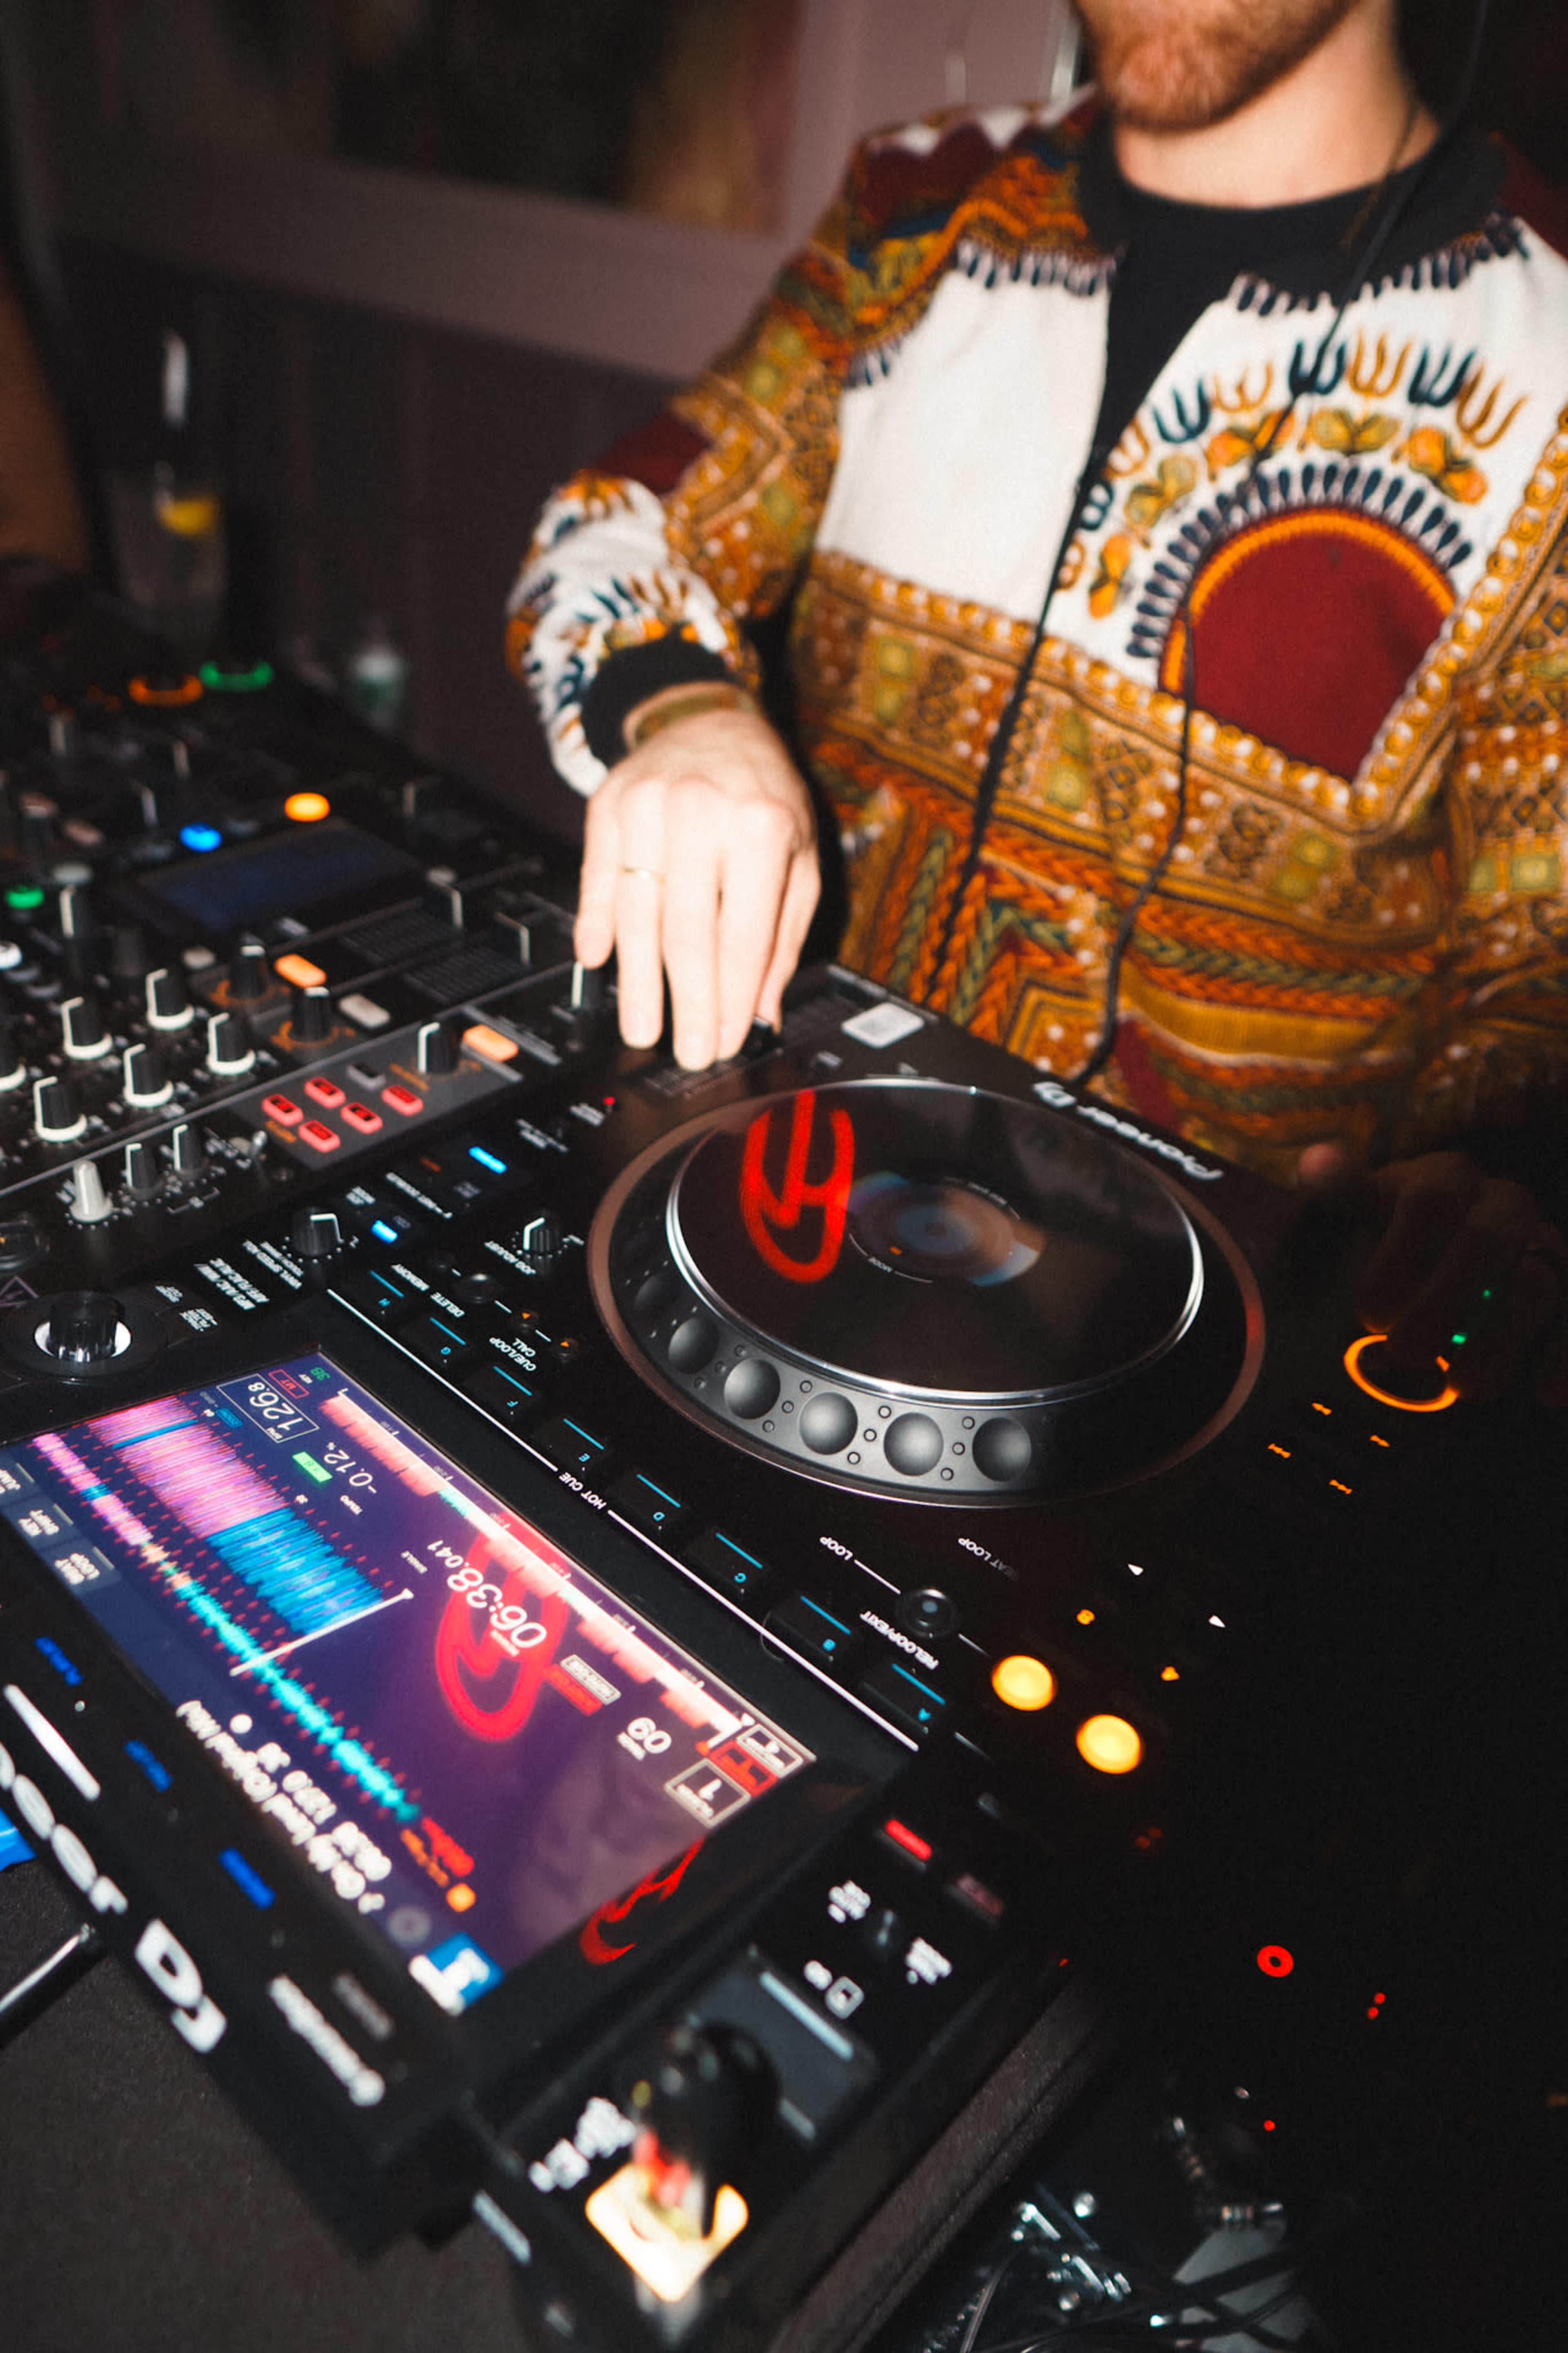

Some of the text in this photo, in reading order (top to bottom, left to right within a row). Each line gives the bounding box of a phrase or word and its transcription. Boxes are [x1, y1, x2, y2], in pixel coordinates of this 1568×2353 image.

[1034, 1082, 1221, 1178] Pioneer DJ
[257, 1251, 283, 1272] SPEED
[485, 1241, 536, 1274] JOG ADJUST
[281, 1270, 301, 1288] VINYL
[392, 1265, 464, 1317] DELETE MEMORY
[490, 1338, 536, 1371] CUE/LOOP
[513, 1338, 535, 1356] CALL
[248, 1382, 303, 1430] 126.8
[579, 1454, 590, 1462] E
[559, 1473, 606, 1509] HOT CUE
[341, 1496, 362, 1514] TEMPO
[653, 1512, 665, 1521] D
[30, 1510, 59, 1535] SHIFT
[820, 1537, 853, 1560] LOOP
[958, 1539, 991, 1560] LOOP
[70, 1554, 100, 1579] LOOP
[735, 1573, 746, 1582] C
[860, 1611, 938, 1669] RELOOP/EXIT
[628, 1718, 671, 1753] 09
[699, 1780, 721, 1800] 1
